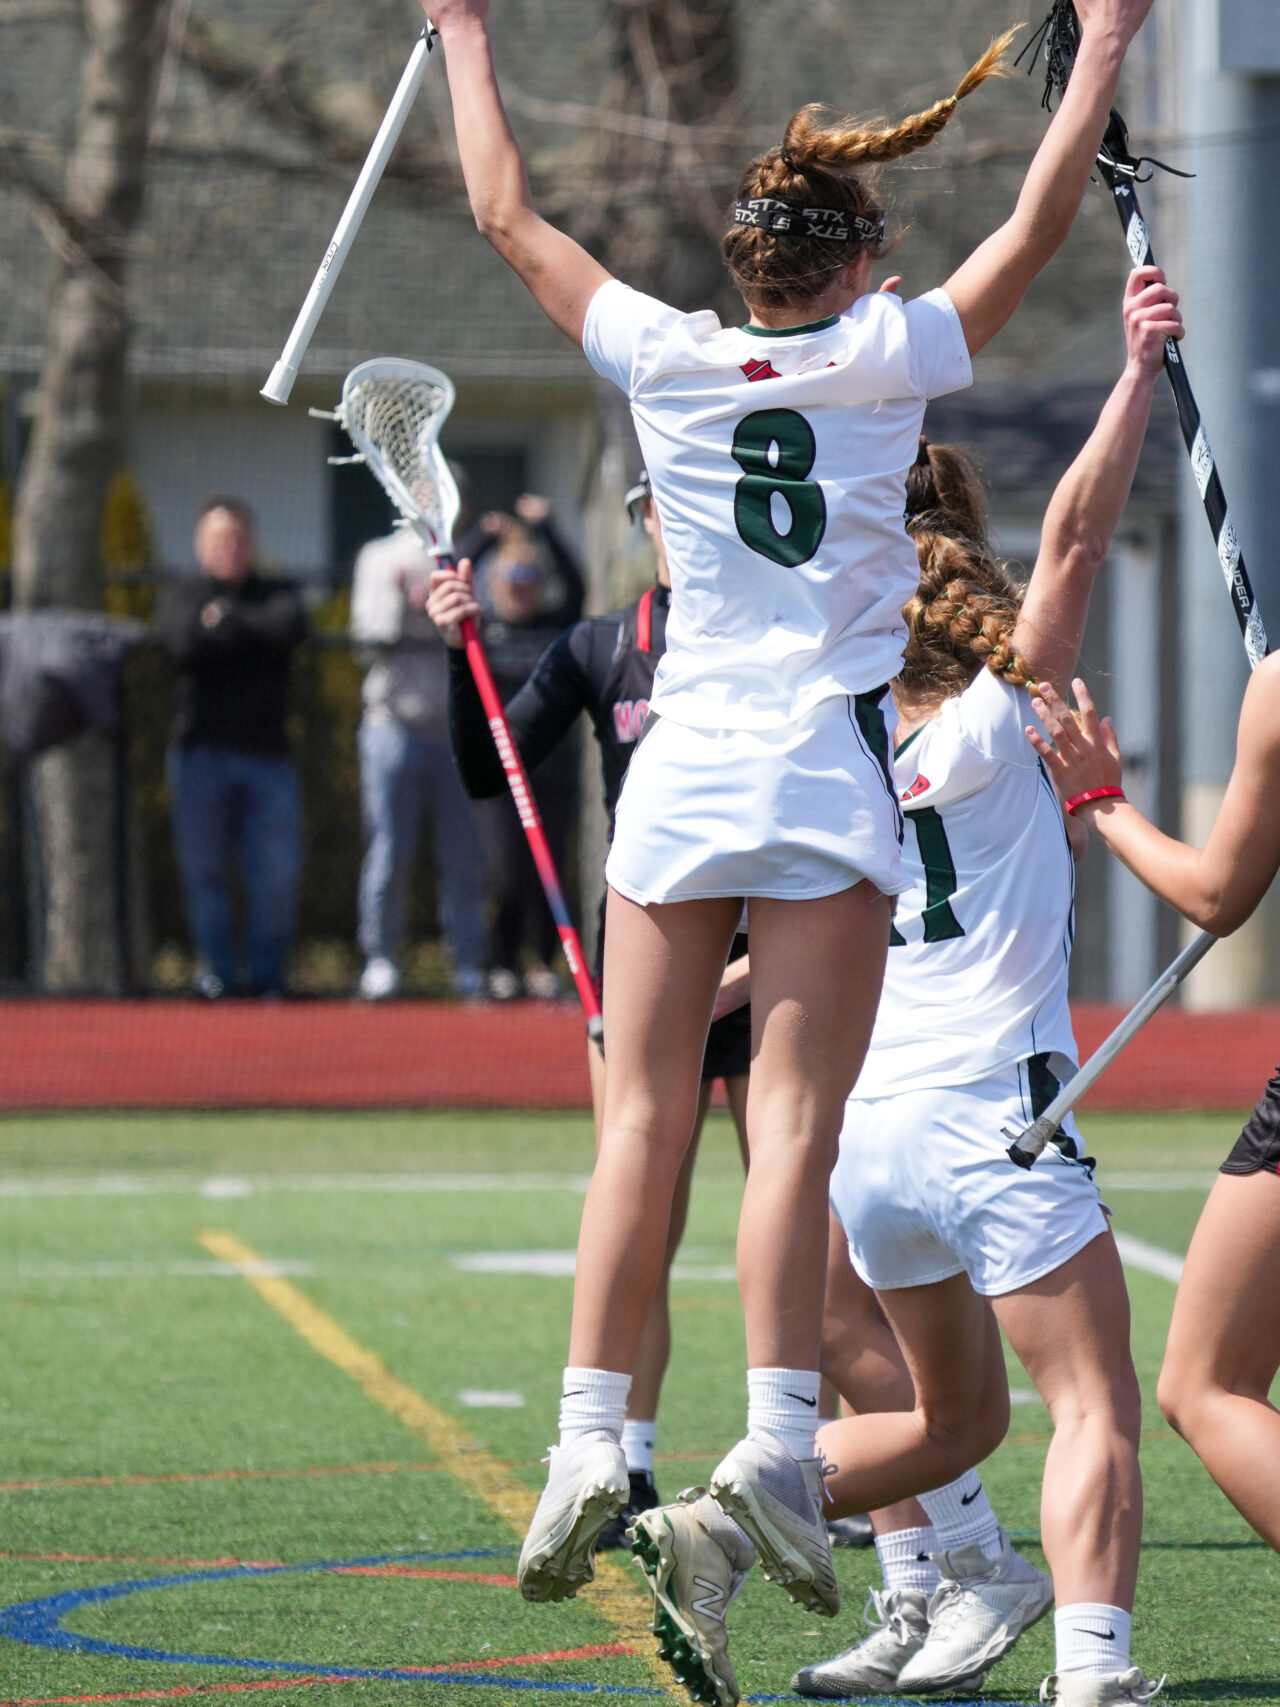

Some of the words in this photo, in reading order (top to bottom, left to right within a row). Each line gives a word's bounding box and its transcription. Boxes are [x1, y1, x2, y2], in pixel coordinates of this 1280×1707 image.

[735, 209, 758, 224] STX
[802, 208, 845, 224] STX
[806, 223, 848, 240] STX
[731, 407, 827, 568] 8
